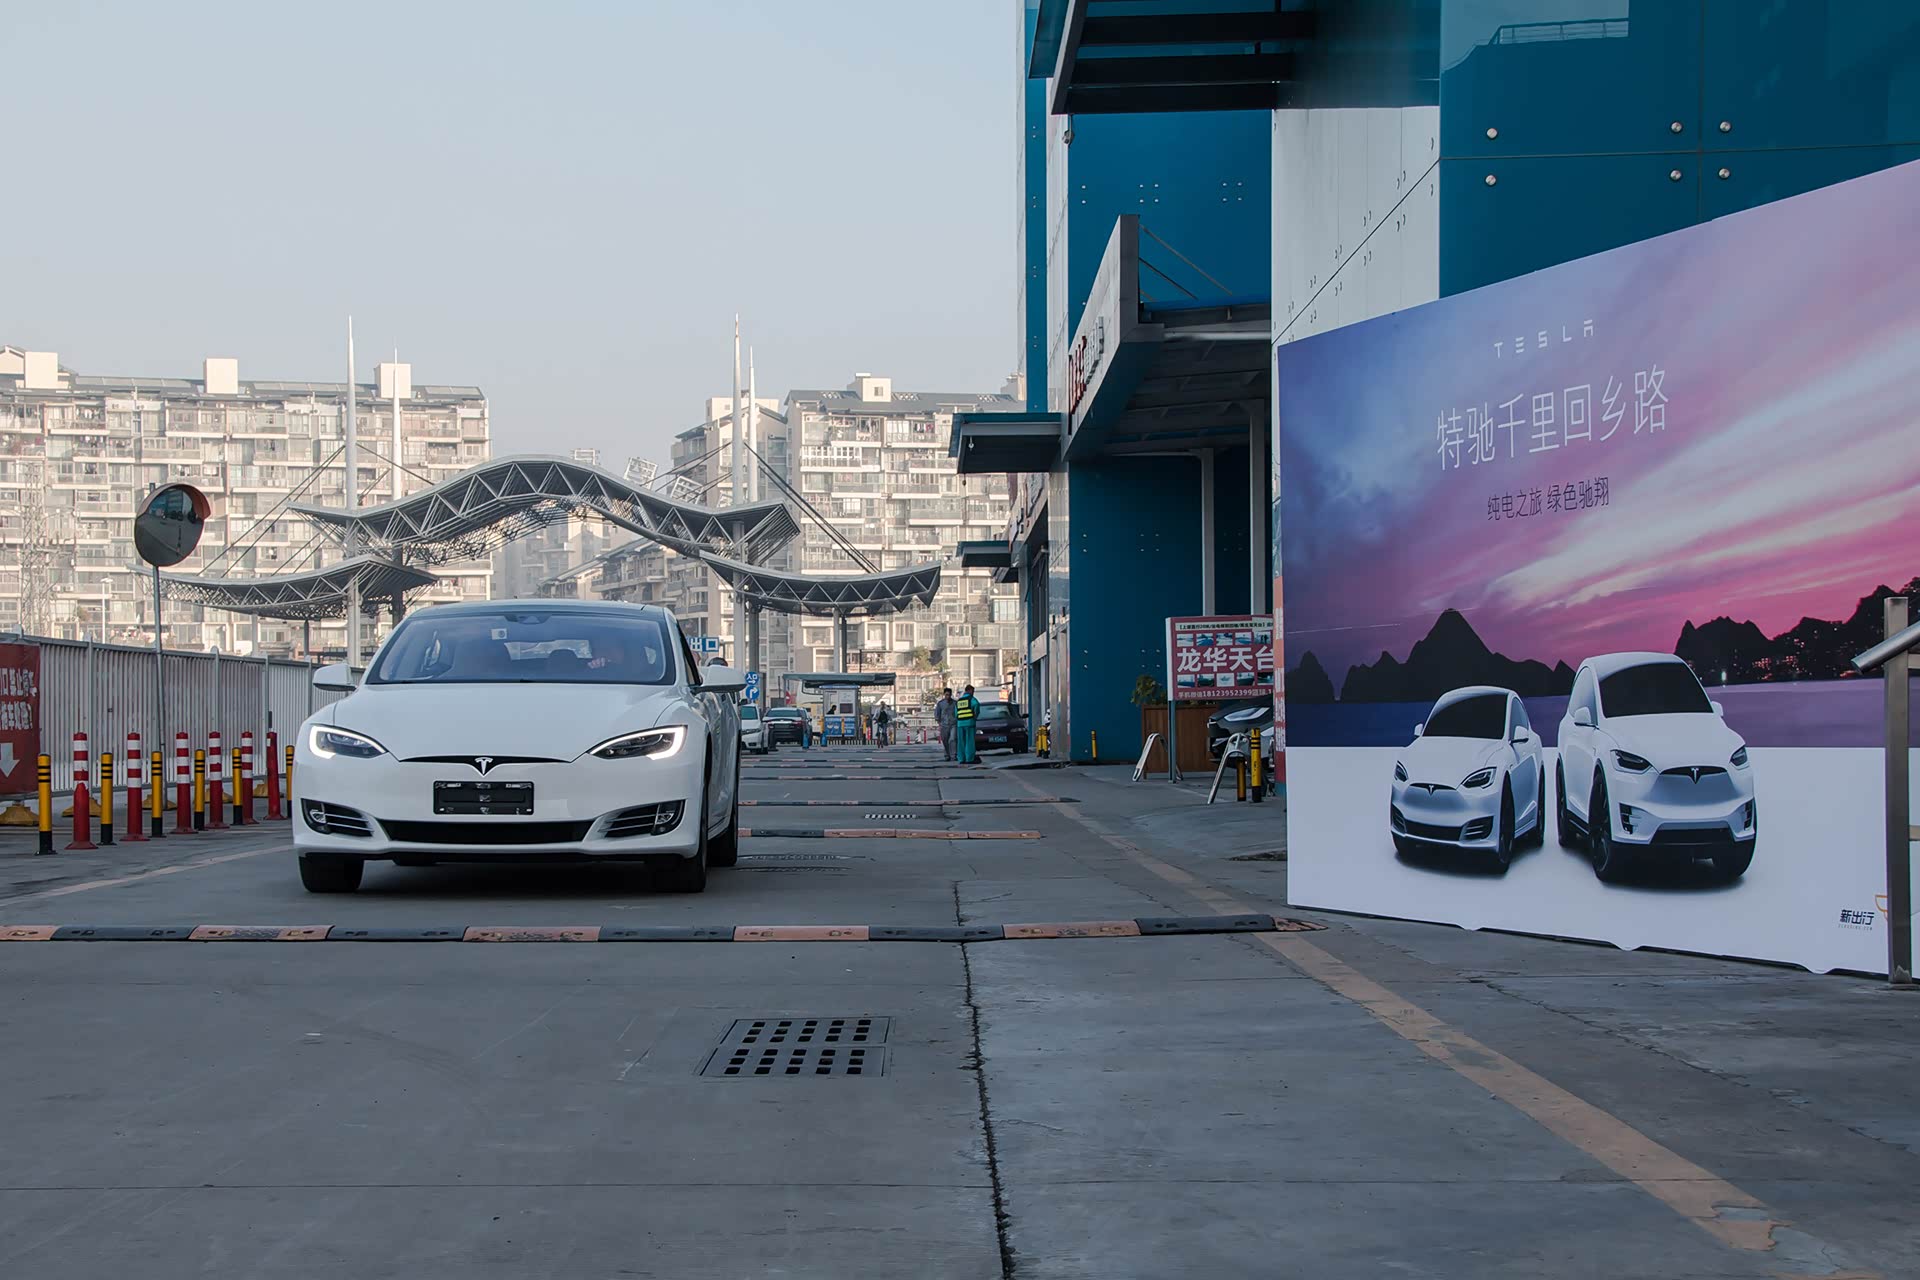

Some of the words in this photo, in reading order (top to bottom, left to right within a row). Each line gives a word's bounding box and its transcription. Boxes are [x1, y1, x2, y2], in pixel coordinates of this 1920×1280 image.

[1493, 319, 1594, 358] TESLA
[1436, 364, 1669, 470] 特驰千里回乡路
[1487, 486, 1543, 521] 纯电之旅
[1546, 476, 1609, 513] 绿色驰翔
[691, 638, 718, 651] 出口
[1176, 646, 1274, 672] 龙华天台
[1839, 909, 1875, 925] 新出行
